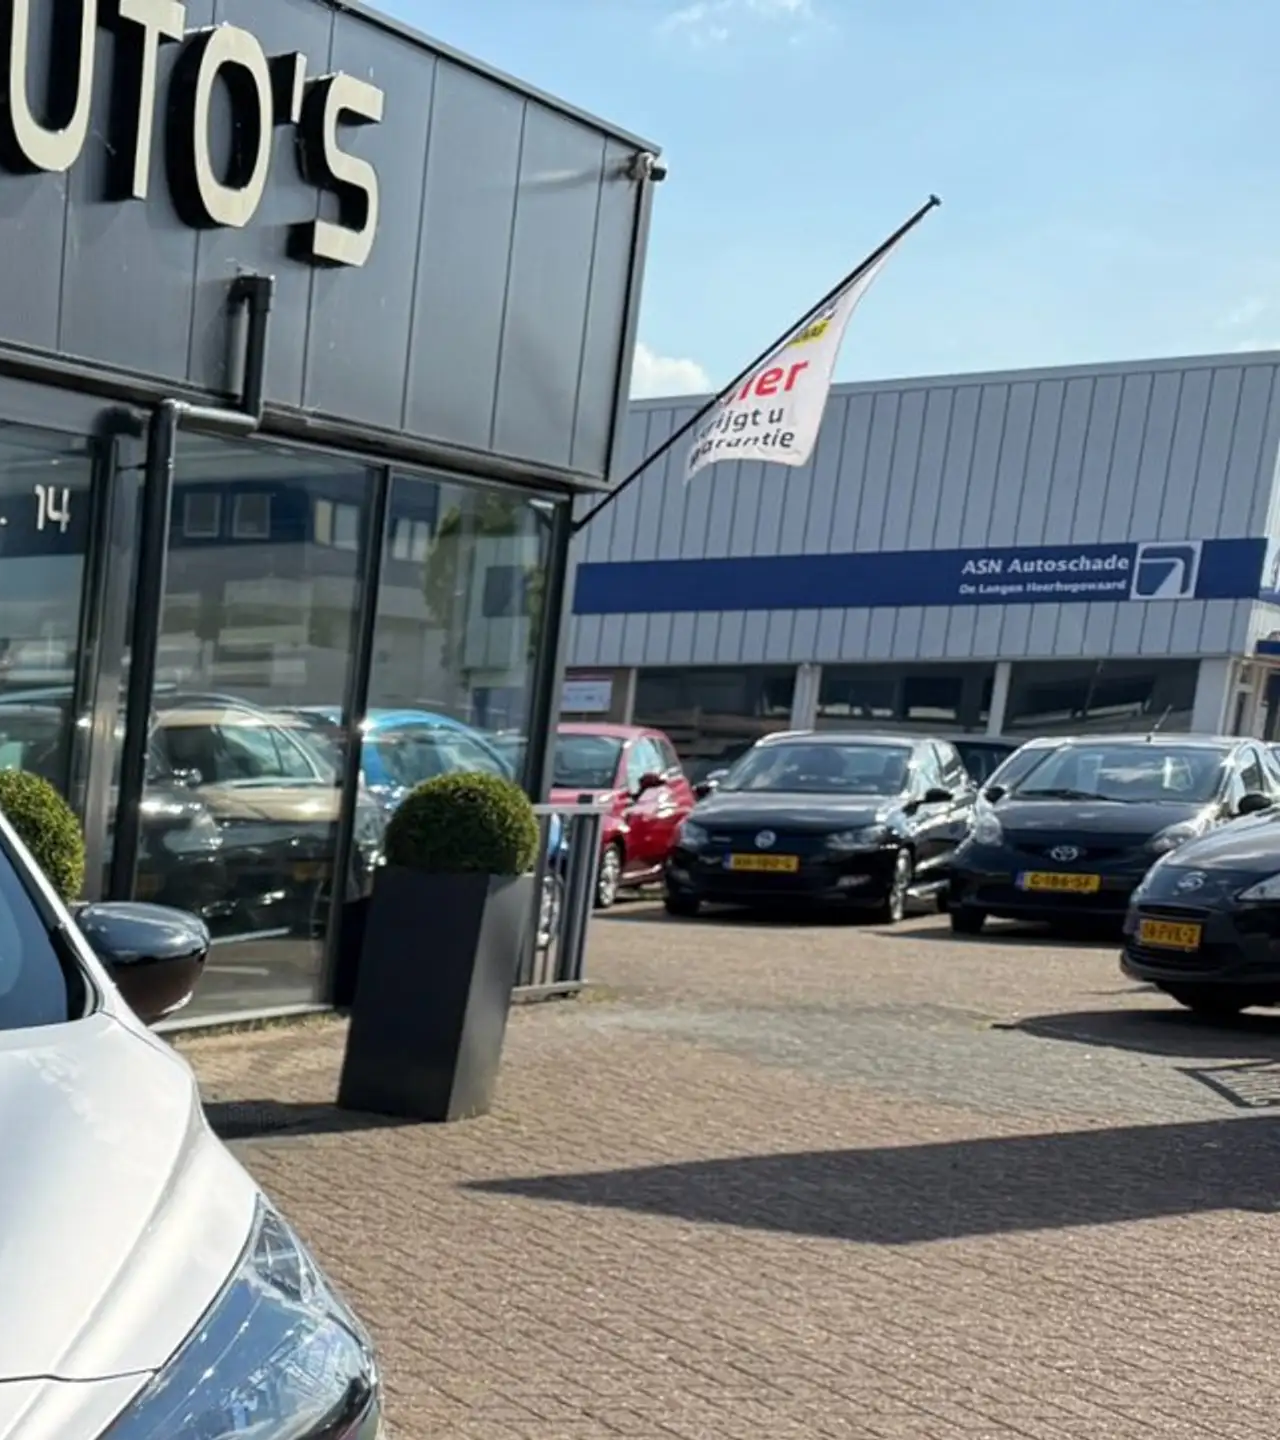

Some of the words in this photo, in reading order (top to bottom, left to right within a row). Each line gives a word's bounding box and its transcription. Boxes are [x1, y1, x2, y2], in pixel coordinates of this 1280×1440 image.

[768, 408, 784, 424] u
[34, 484, 70, 533] 14
[961, 558, 1002, 575] ASN
[1007, 554, 1129, 574] Autoschade
